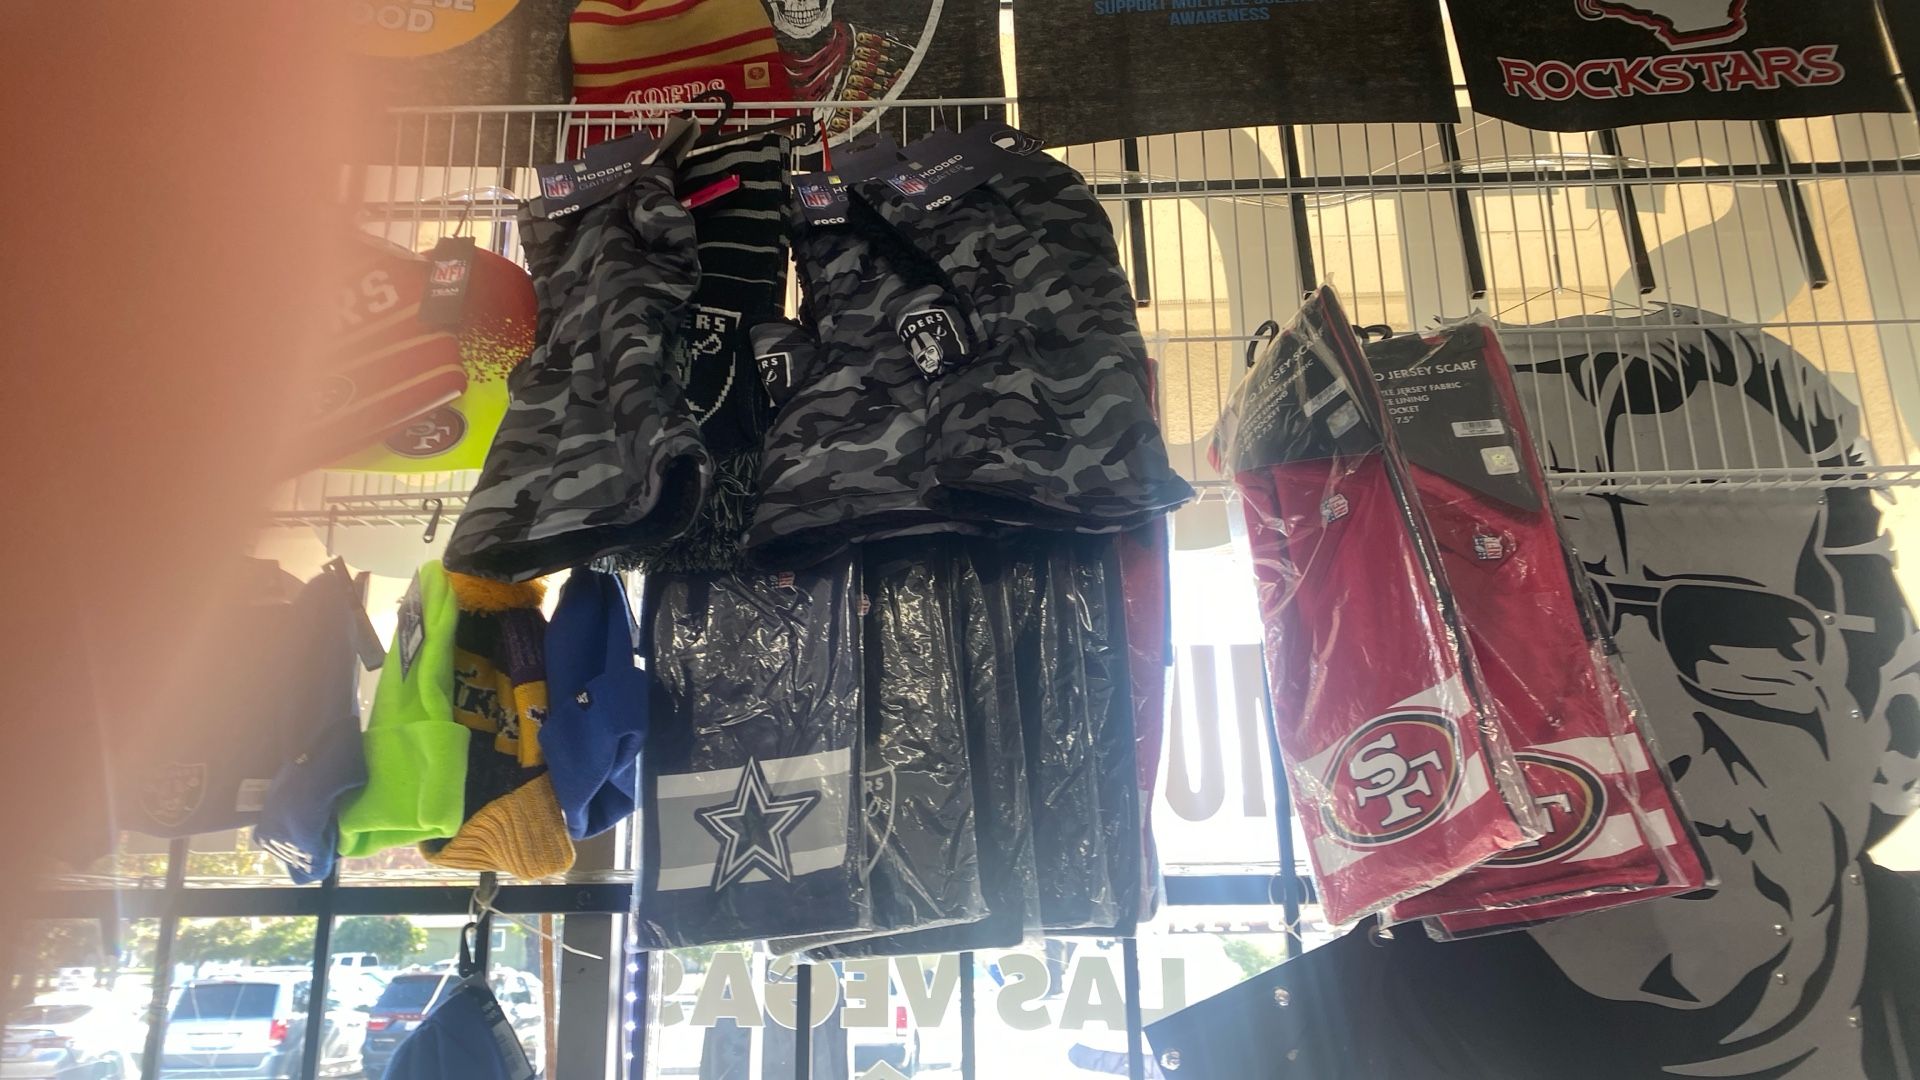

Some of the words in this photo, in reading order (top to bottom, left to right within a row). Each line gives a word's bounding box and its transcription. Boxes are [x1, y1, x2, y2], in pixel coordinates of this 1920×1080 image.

[1094, 0, 1166, 16] SUPPORT
[1169, 7, 1271, 26] AWARENESS
[349, 3, 435, 33] OOD
[1497, 44, 1845, 101] ROCKSTARS
[577, 161, 632, 183] HOODED
[921, 154, 964, 179] HOODED
[548, 204, 580, 220] FOCO
[926, 195, 952, 211] FOCO
[814, 216, 845, 226] FOCO
[901, 313, 943, 342] IDERS
[1258, 359, 1291, 394] JERSEY
[1388, 366, 1432, 380] JERSEY
[1436, 360, 1478, 375] SCARF
[1396, 384, 1427, 396] JERSEY
[1429, 381, 1462, 392] FABRIC
[1395, 395, 1430, 405] LINING
[1388, 405, 1419, 415] OCKET
